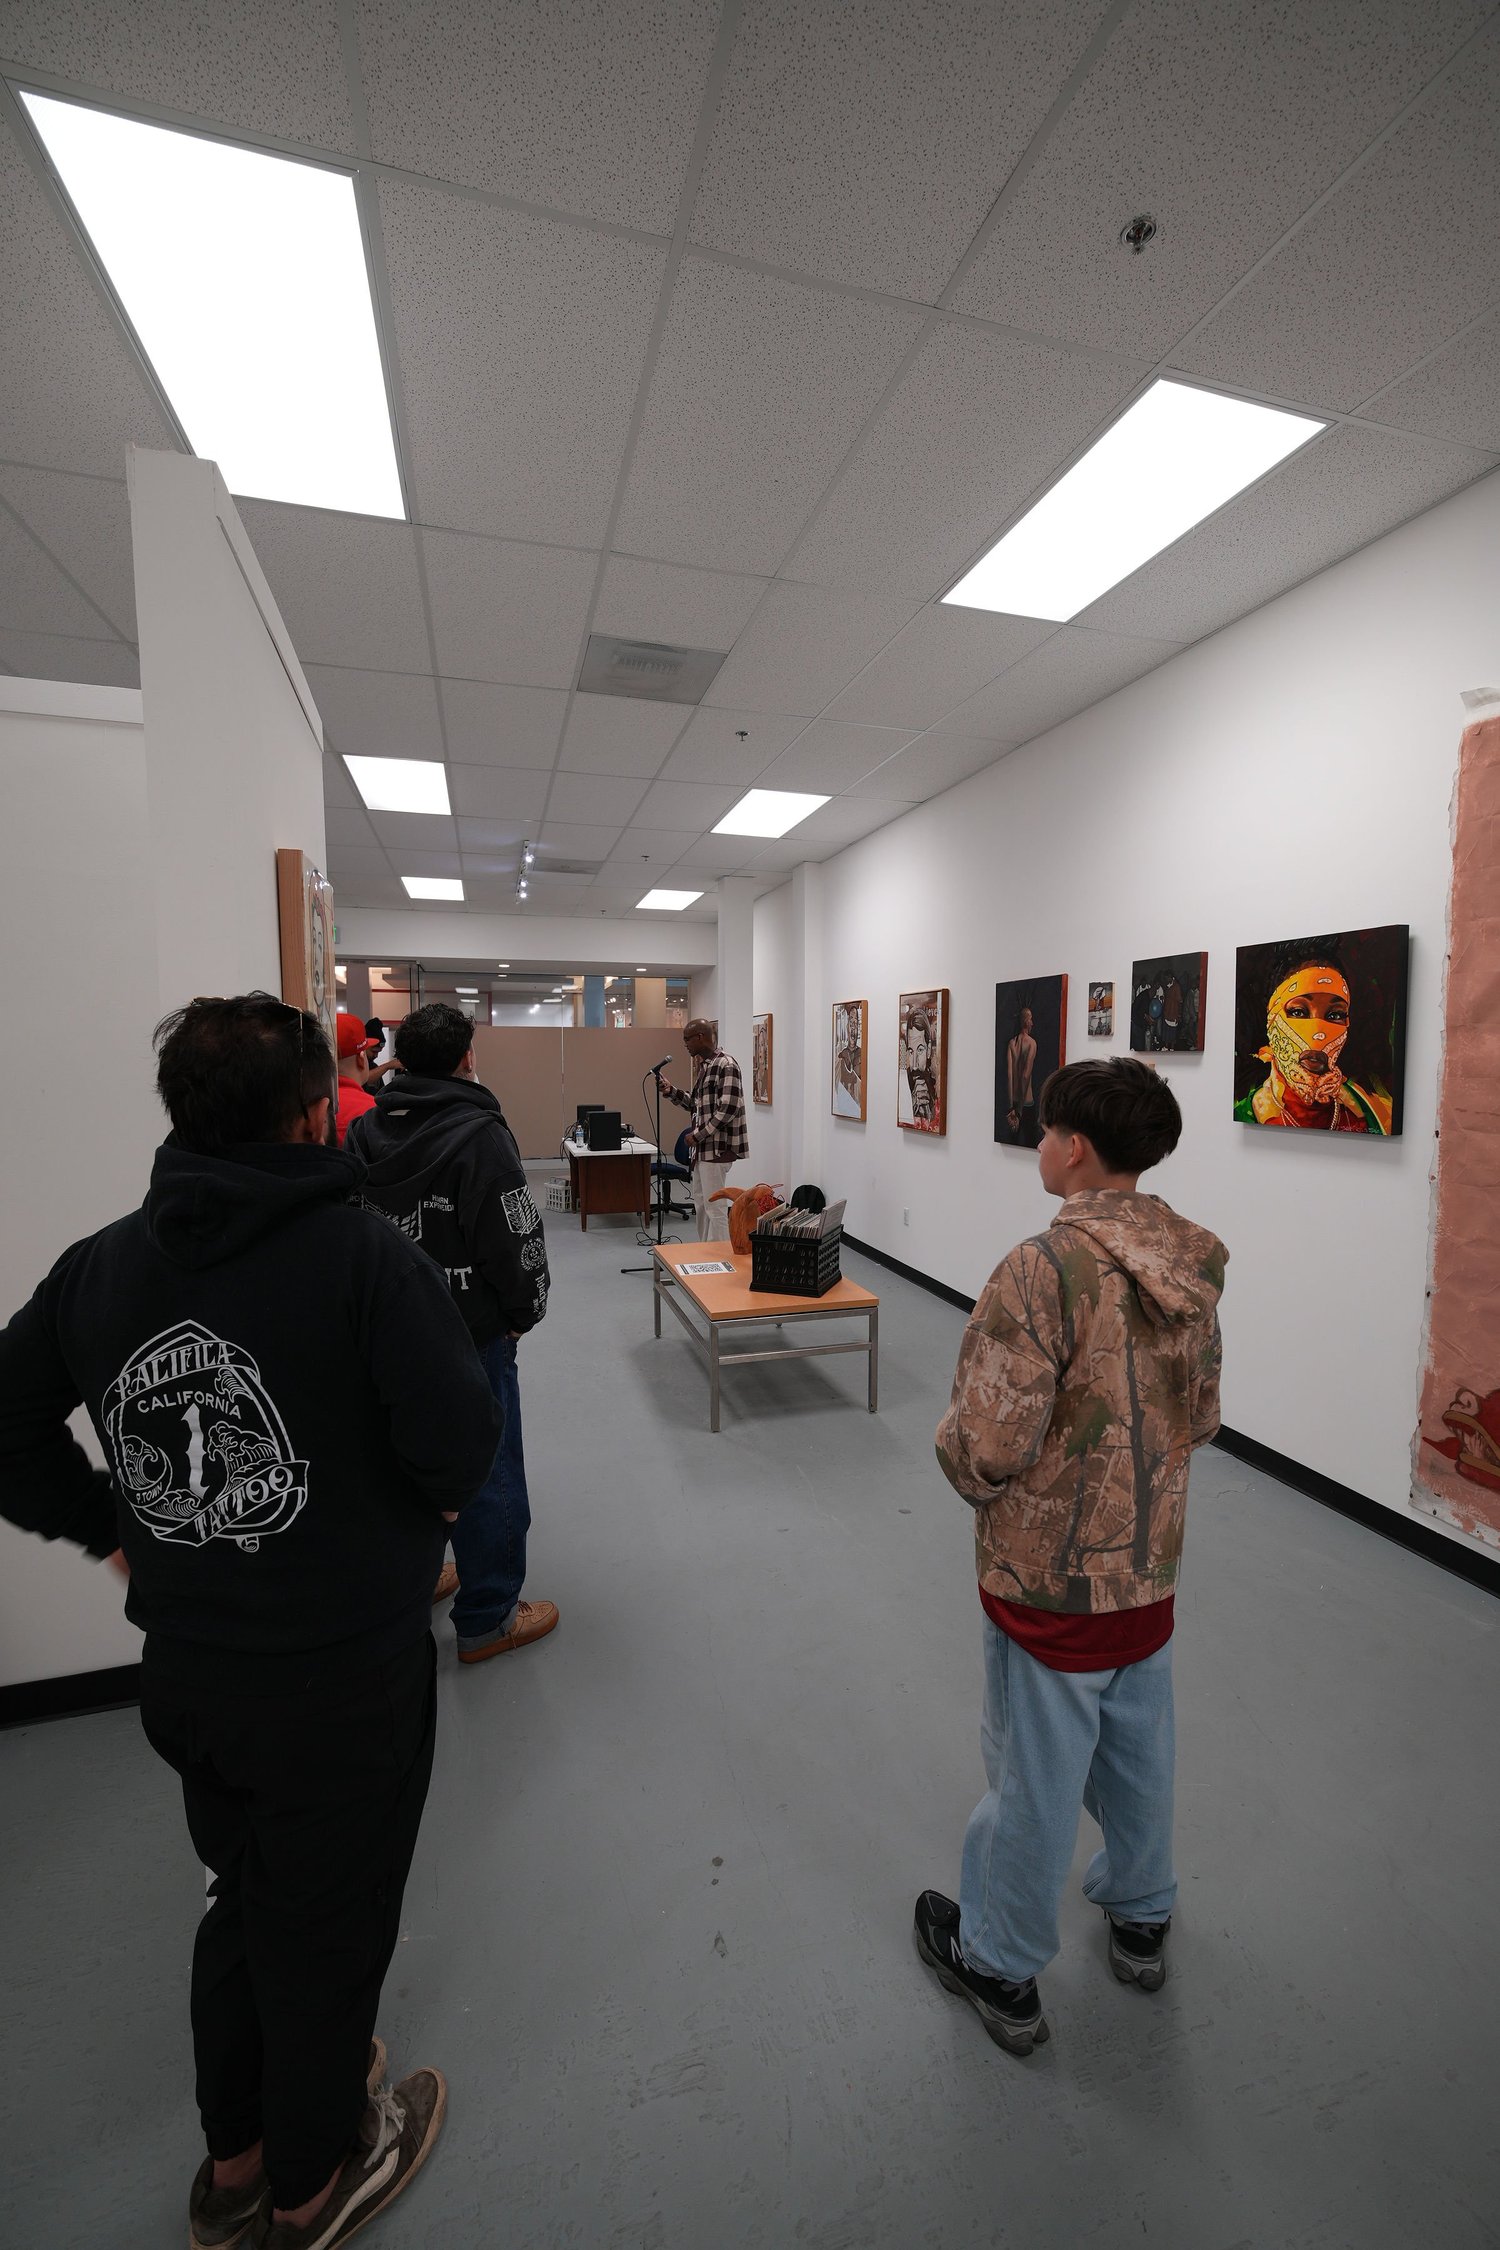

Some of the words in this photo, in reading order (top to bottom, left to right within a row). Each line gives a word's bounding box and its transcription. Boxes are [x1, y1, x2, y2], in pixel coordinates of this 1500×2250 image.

[114, 1342, 237, 1401] PACIFICA
[137, 1390, 242, 1420] CALIFORNIA
[193, 1465, 294, 1541] TATTOO
